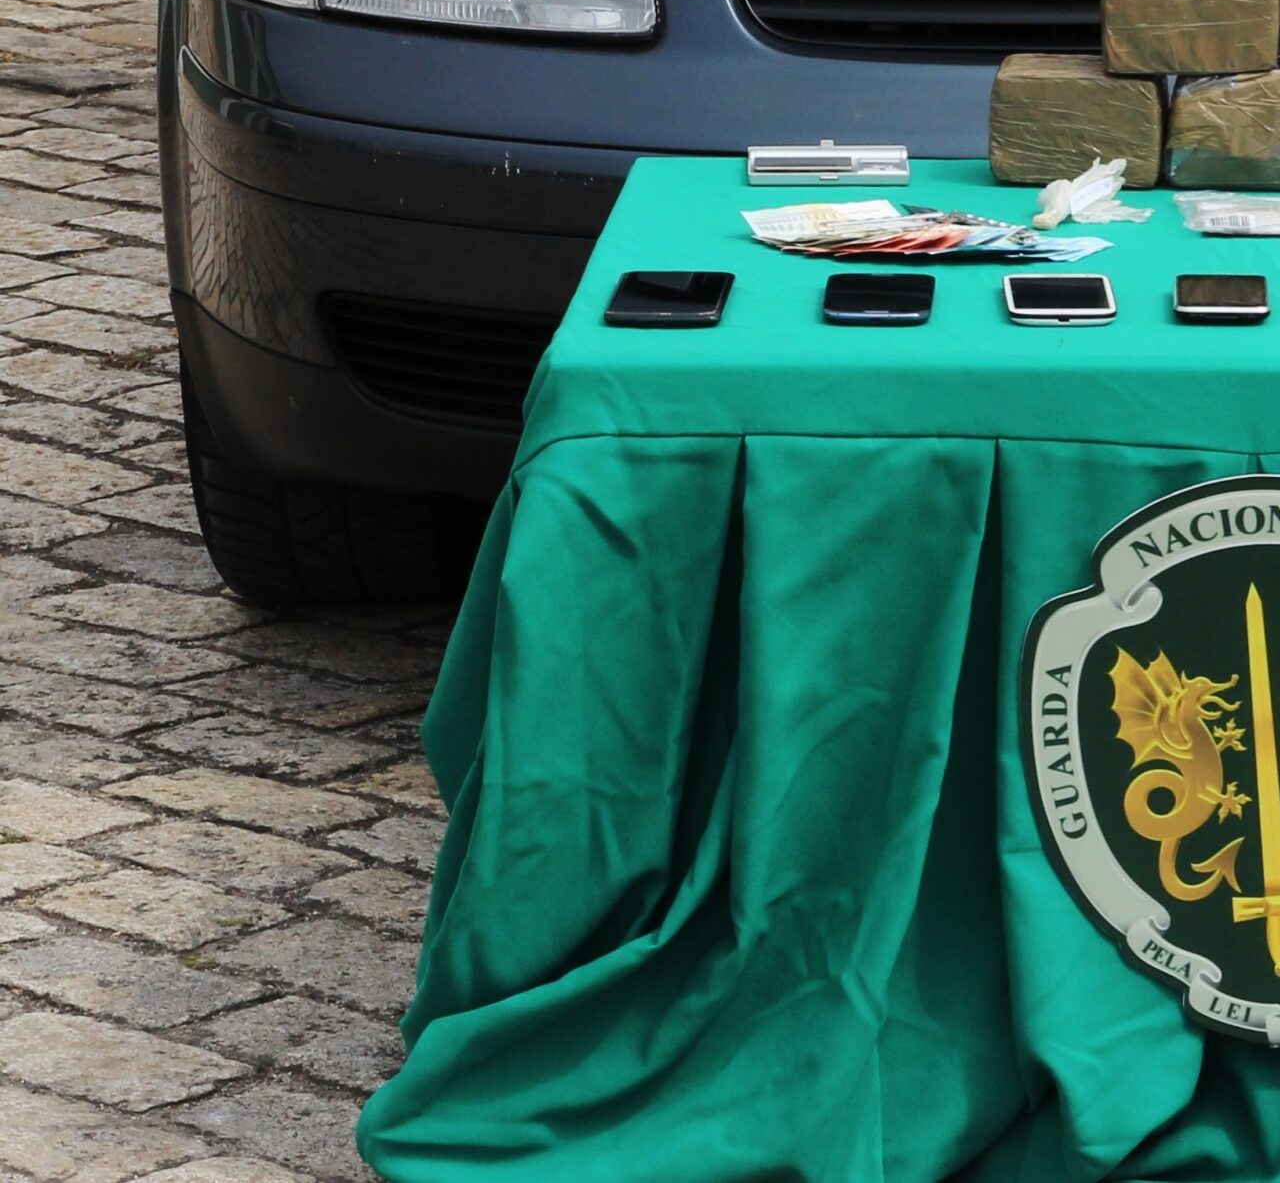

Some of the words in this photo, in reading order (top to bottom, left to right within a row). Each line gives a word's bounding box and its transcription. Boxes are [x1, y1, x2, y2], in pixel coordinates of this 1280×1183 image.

[1040, 662, 1088, 840] GUARDA
[1141, 939, 1193, 979] PELA
[1208, 996, 1252, 1023] LEI
